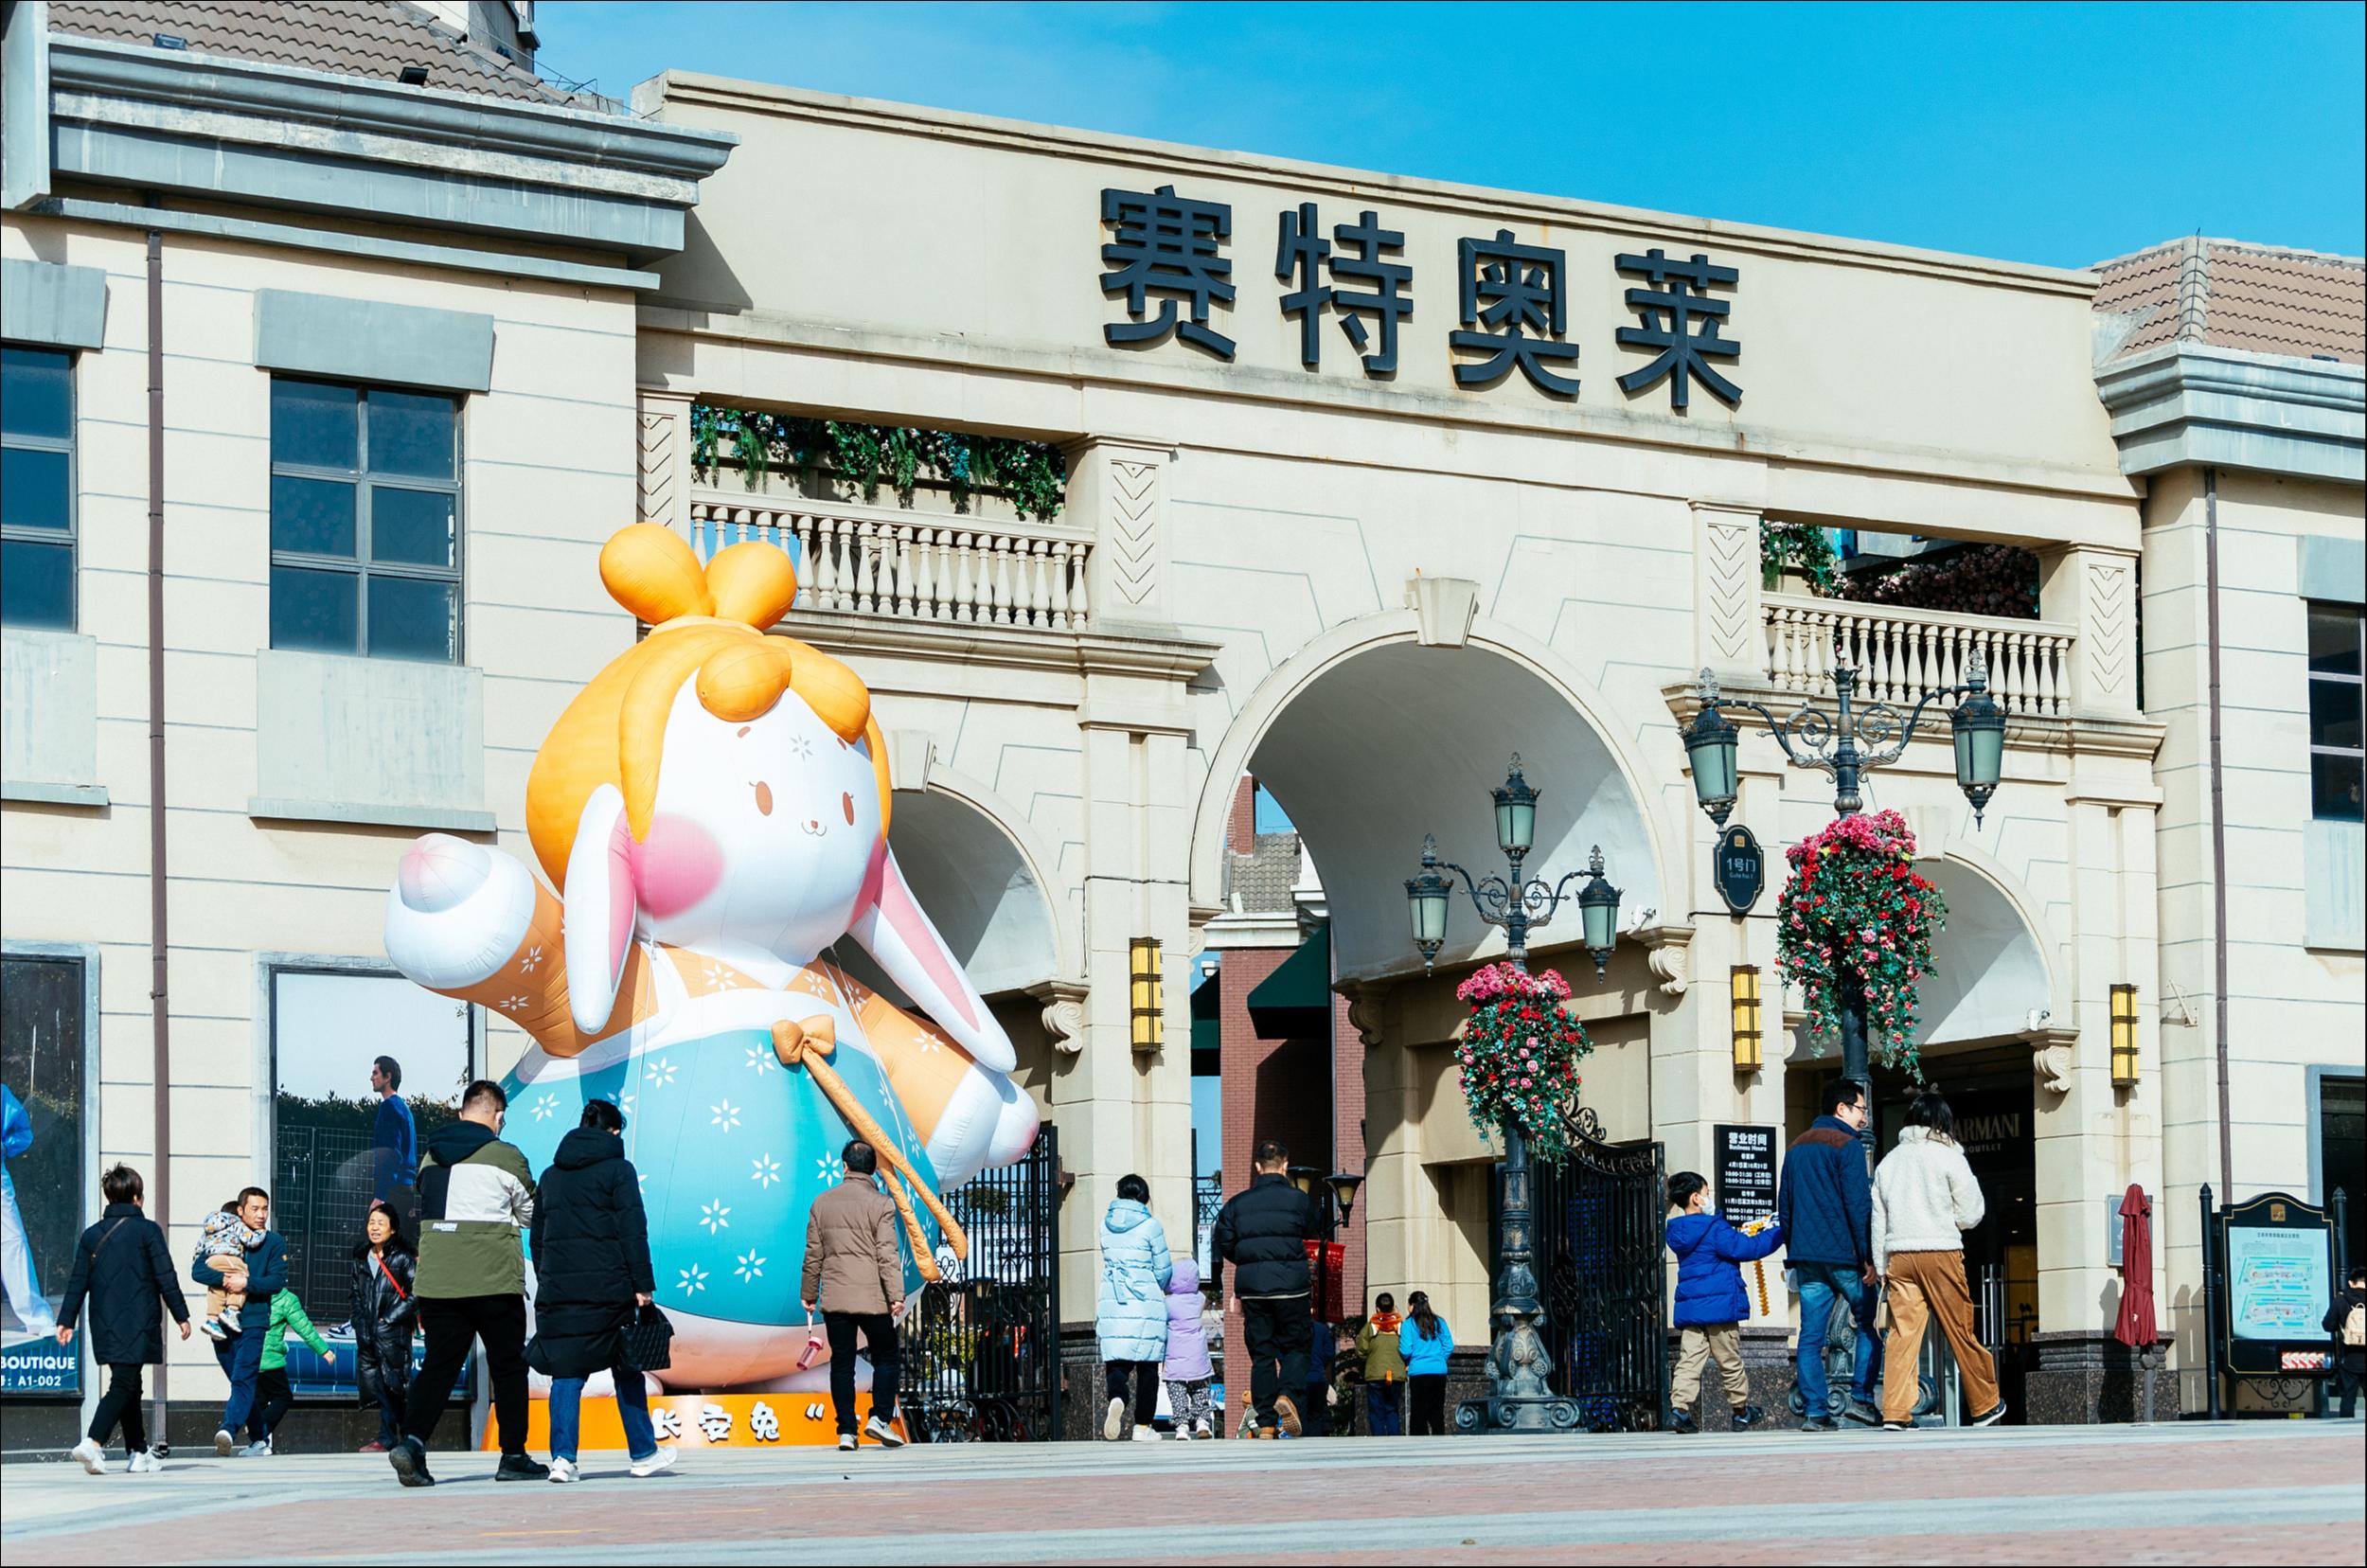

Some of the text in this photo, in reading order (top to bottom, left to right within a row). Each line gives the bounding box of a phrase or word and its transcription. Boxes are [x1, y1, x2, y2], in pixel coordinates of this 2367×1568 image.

[1099, 185, 1744, 408] 赛特奥莱
[1727, 857, 1756, 872] 1号门
[1953, 1114, 2020, 1142] ARMANI
[1729, 1132, 1767, 1146] 营业时间
[1968, 1143, 2002, 1153] OUTLET
